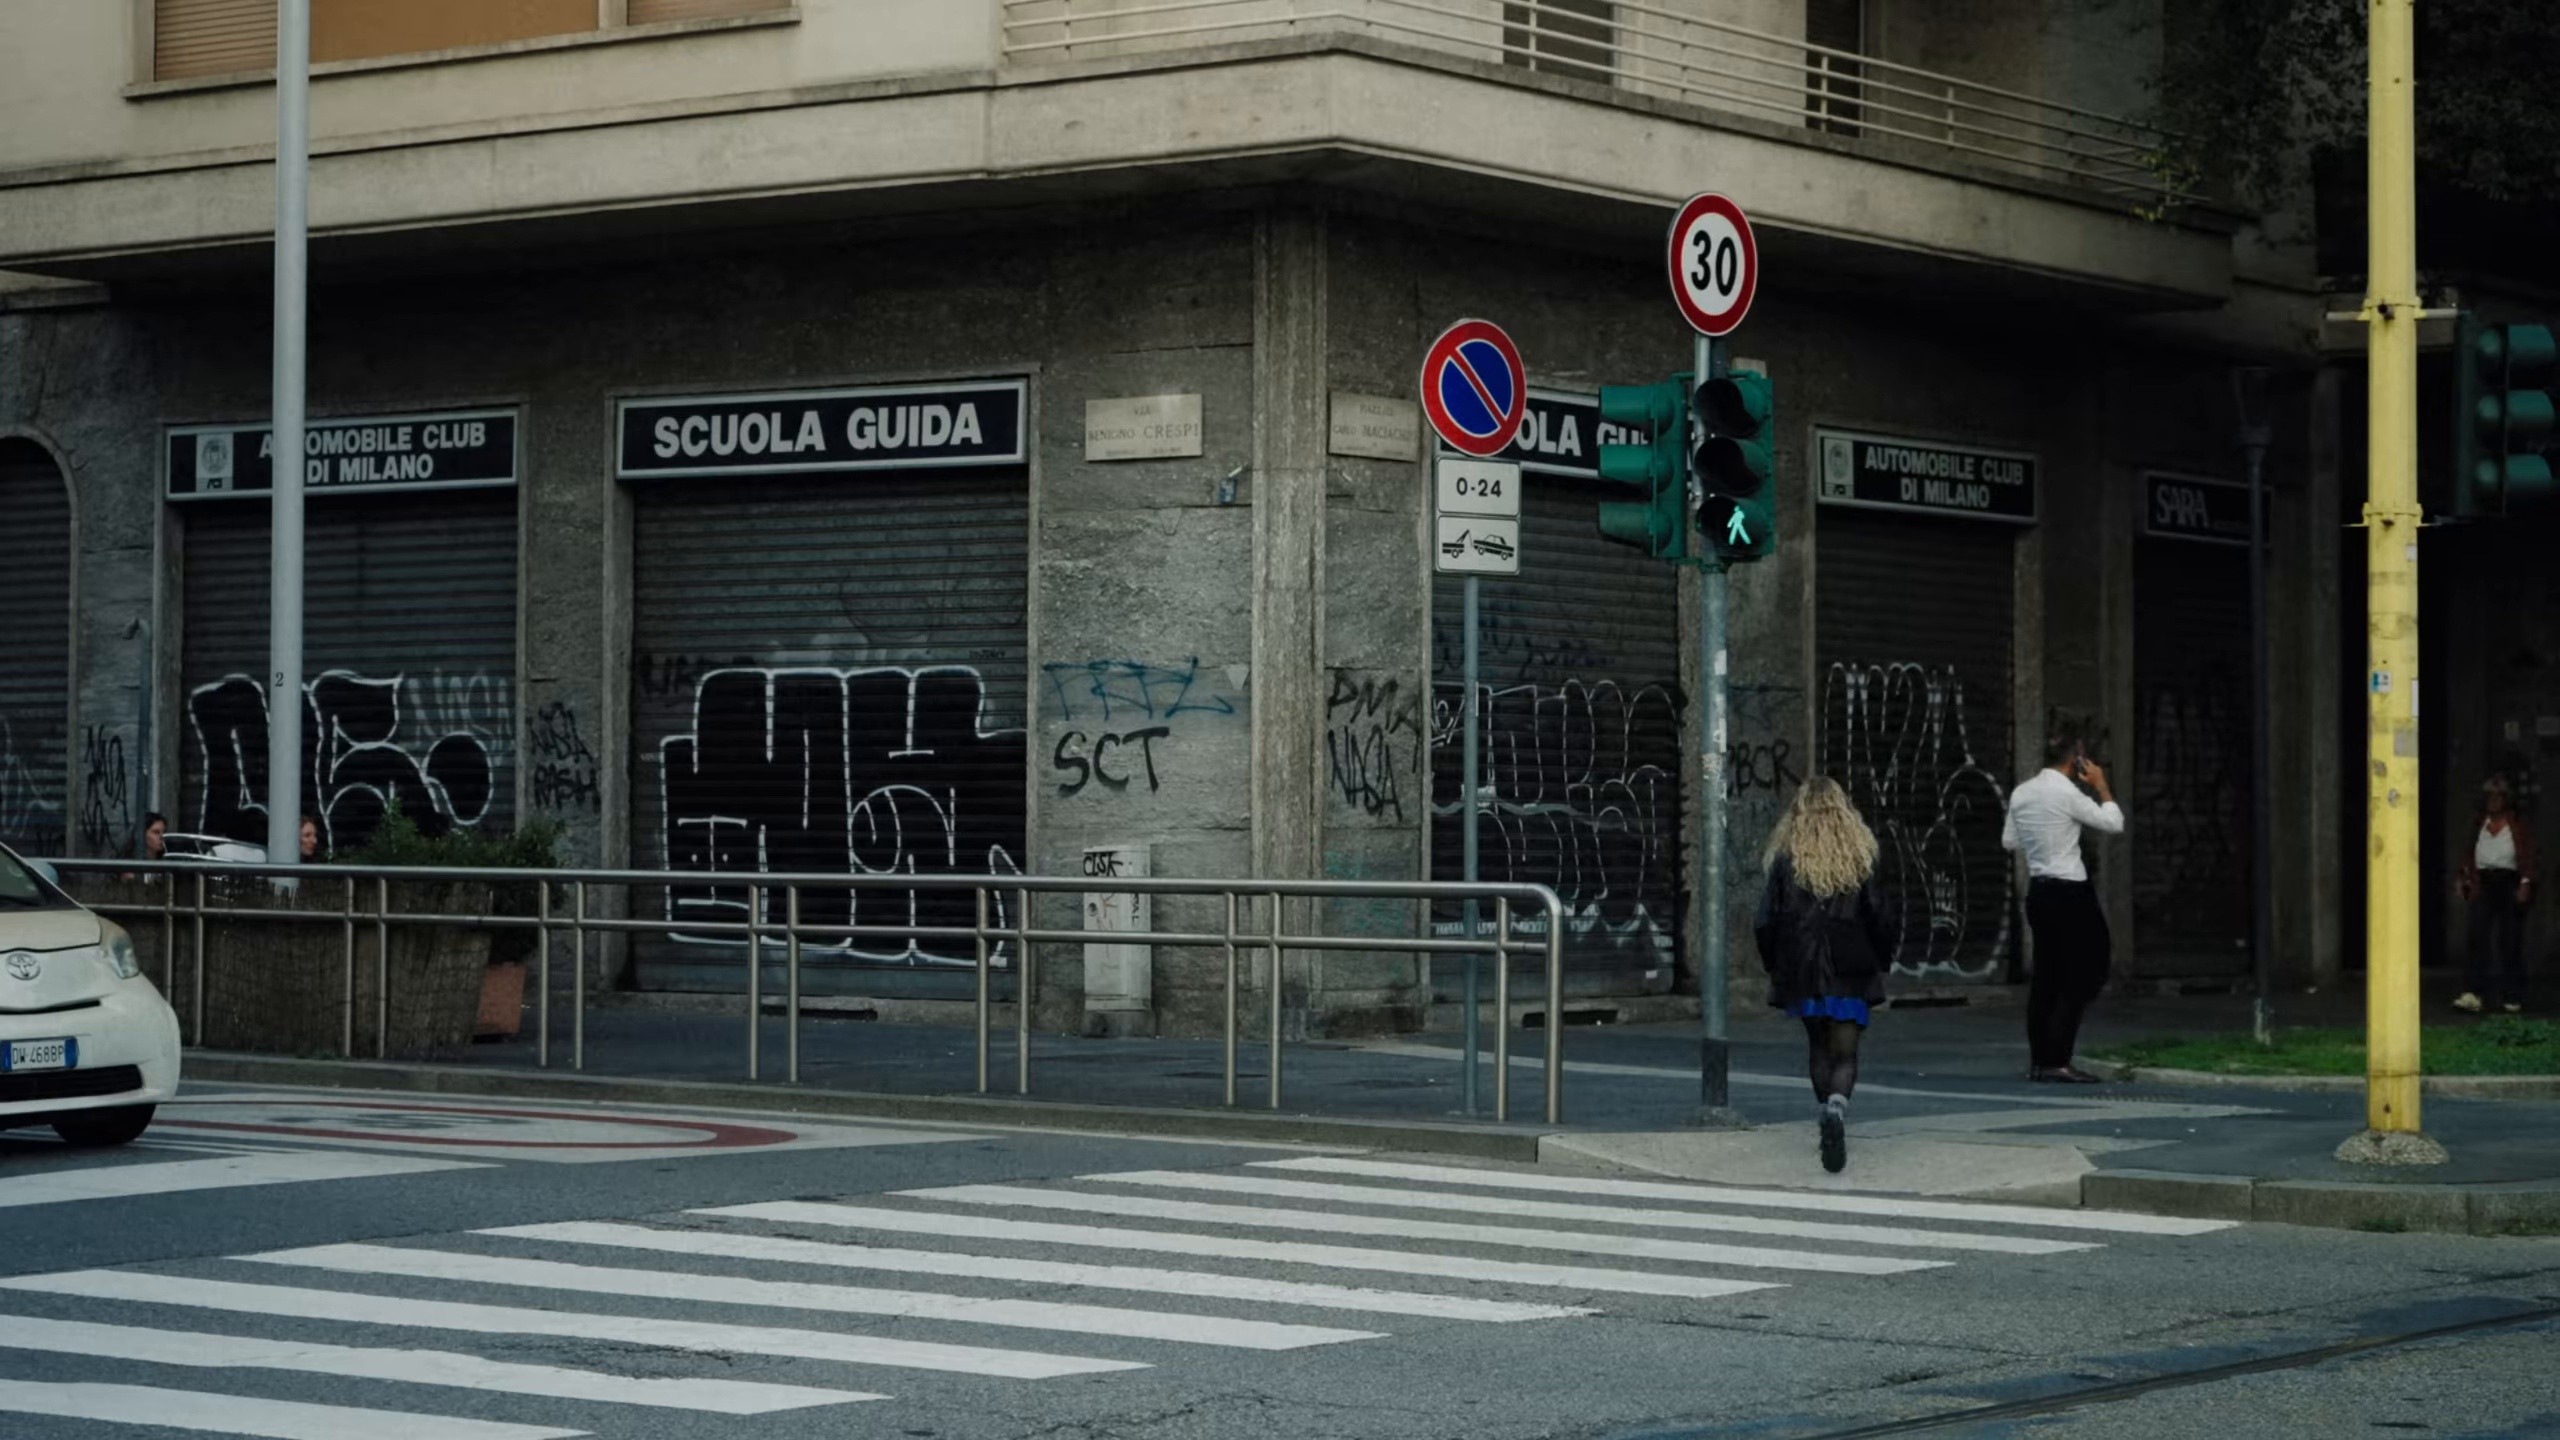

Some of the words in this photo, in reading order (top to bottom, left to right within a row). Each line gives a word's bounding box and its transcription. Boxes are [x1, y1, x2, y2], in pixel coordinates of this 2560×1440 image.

[1690, 229, 1738, 297] 30
[258, 425, 413, 460] AOMOBILE
[422, 421, 487, 450] CLUB
[653, 410, 827, 459] SCUOLA
[846, 402, 984, 452] GUIDA
[1143, 422, 1200, 440] CRESPI
[306, 459, 330, 484] DI
[338, 453, 435, 484] MILANO
[1864, 445, 1977, 481] AUTOMOBILE
[1981, 457, 2026, 487] CLUB
[1456, 476, 1502, 498] 0-24
[1899, 475, 1918, 502] DI
[1923, 480, 1991, 509] MILANO
[2155, 483, 2209, 530] SARA
[275, 671, 285, 688] 2
[1053, 726, 1170, 799] SCT
